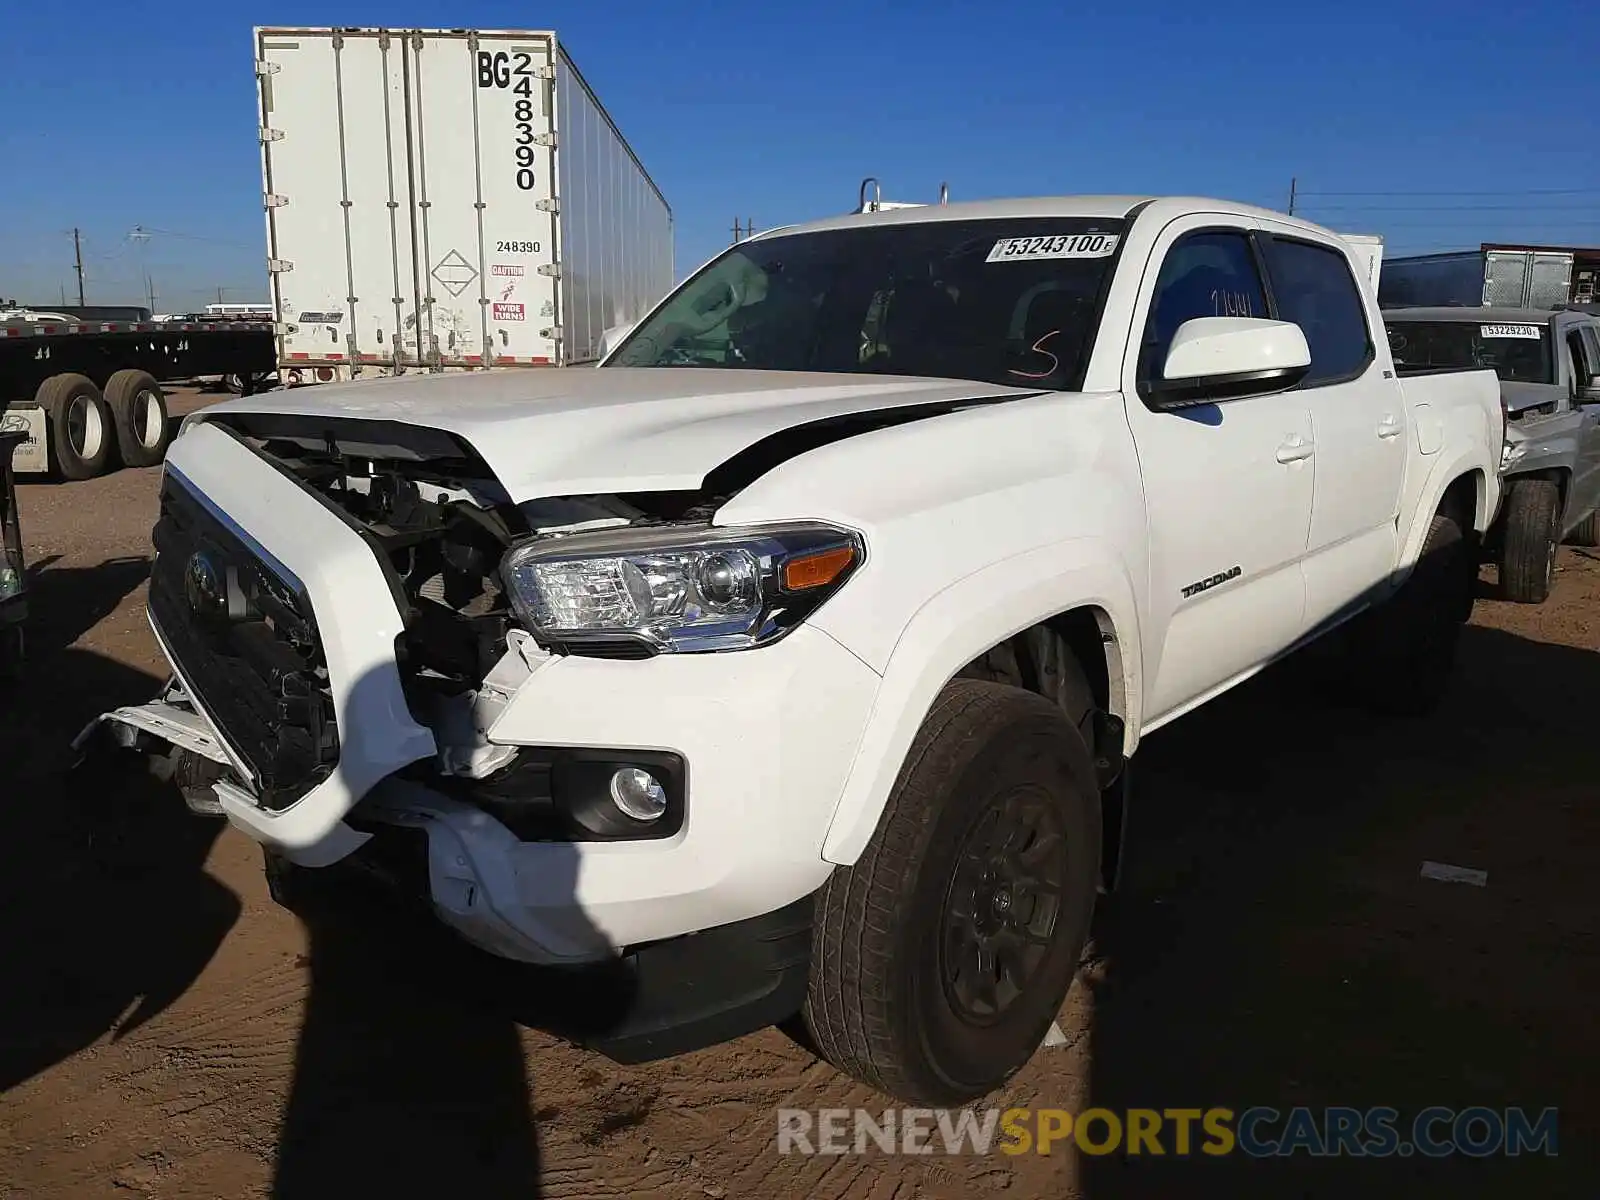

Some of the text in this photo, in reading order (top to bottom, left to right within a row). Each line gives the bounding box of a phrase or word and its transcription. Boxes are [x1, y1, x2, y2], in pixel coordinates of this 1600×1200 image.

[478, 51, 510, 88] BG
[512, 53, 535, 190] 248390
[497, 241, 541, 253] 248390
[1005, 236, 1105, 256] 53243100
[495, 312, 524, 321] TURNS
[497, 304, 521, 313] WIDE
[1181, 566, 1242, 599] TACOMA
